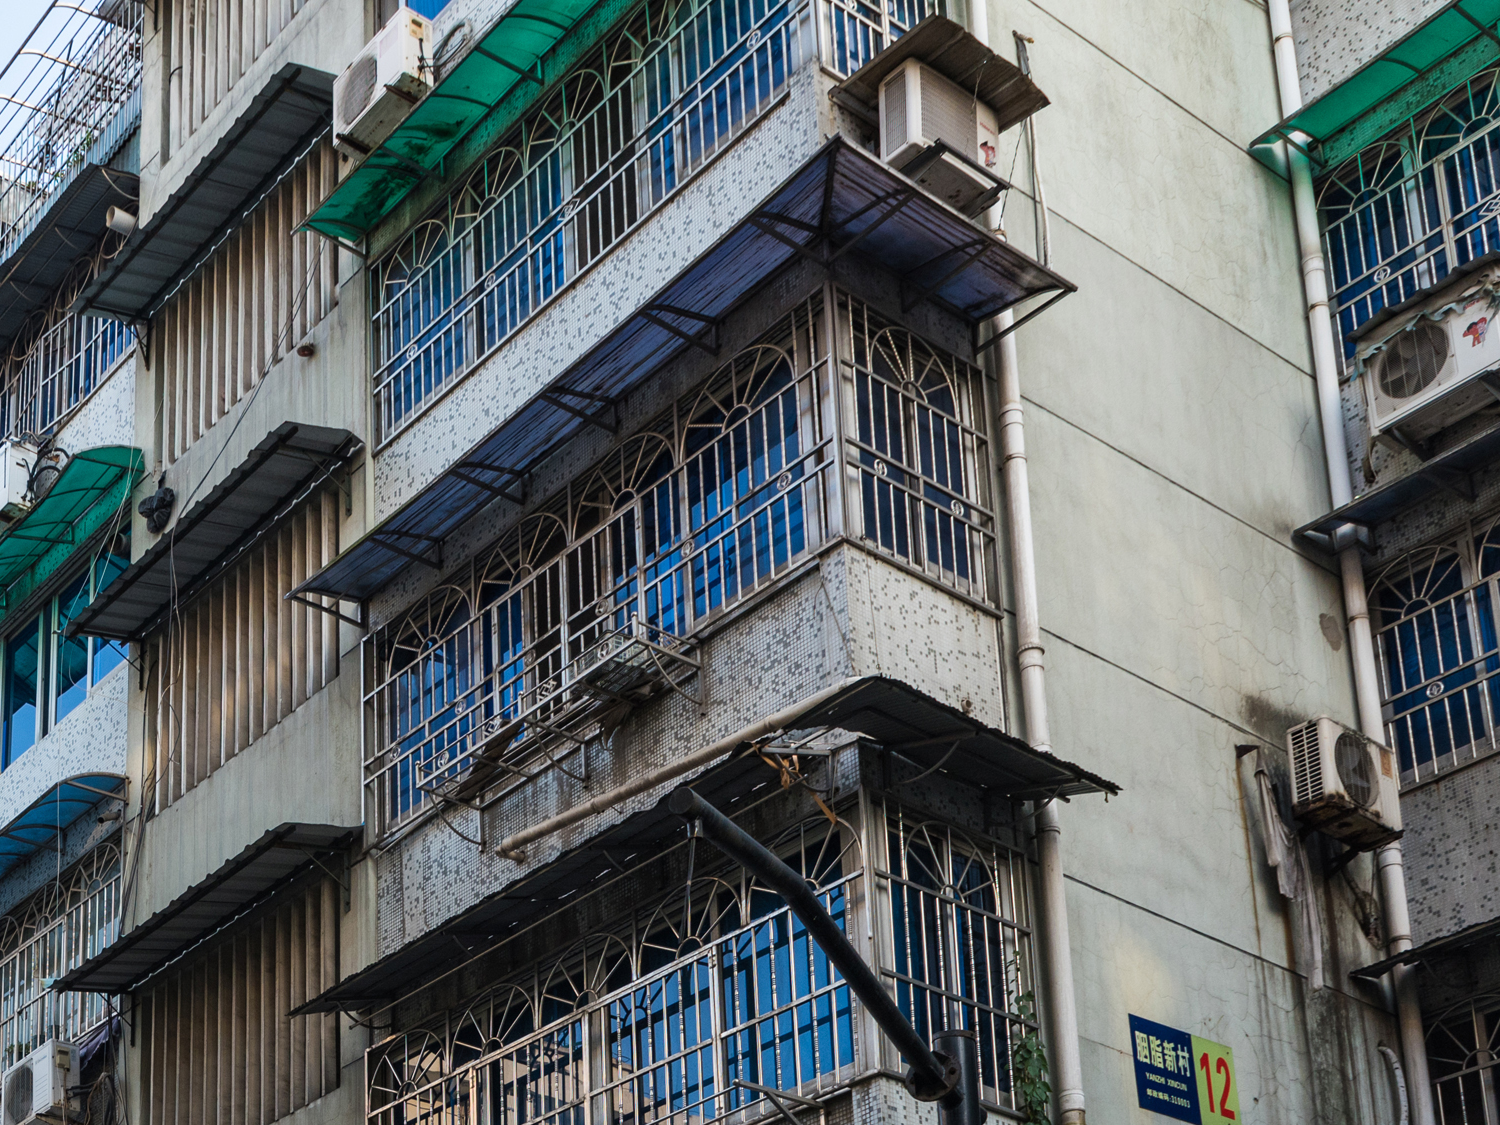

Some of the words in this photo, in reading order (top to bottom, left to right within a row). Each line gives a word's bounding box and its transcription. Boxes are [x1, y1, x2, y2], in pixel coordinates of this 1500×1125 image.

[1134, 1030, 1190, 1078] 胭脂新村
[1200, 1052, 1236, 1121] 12
